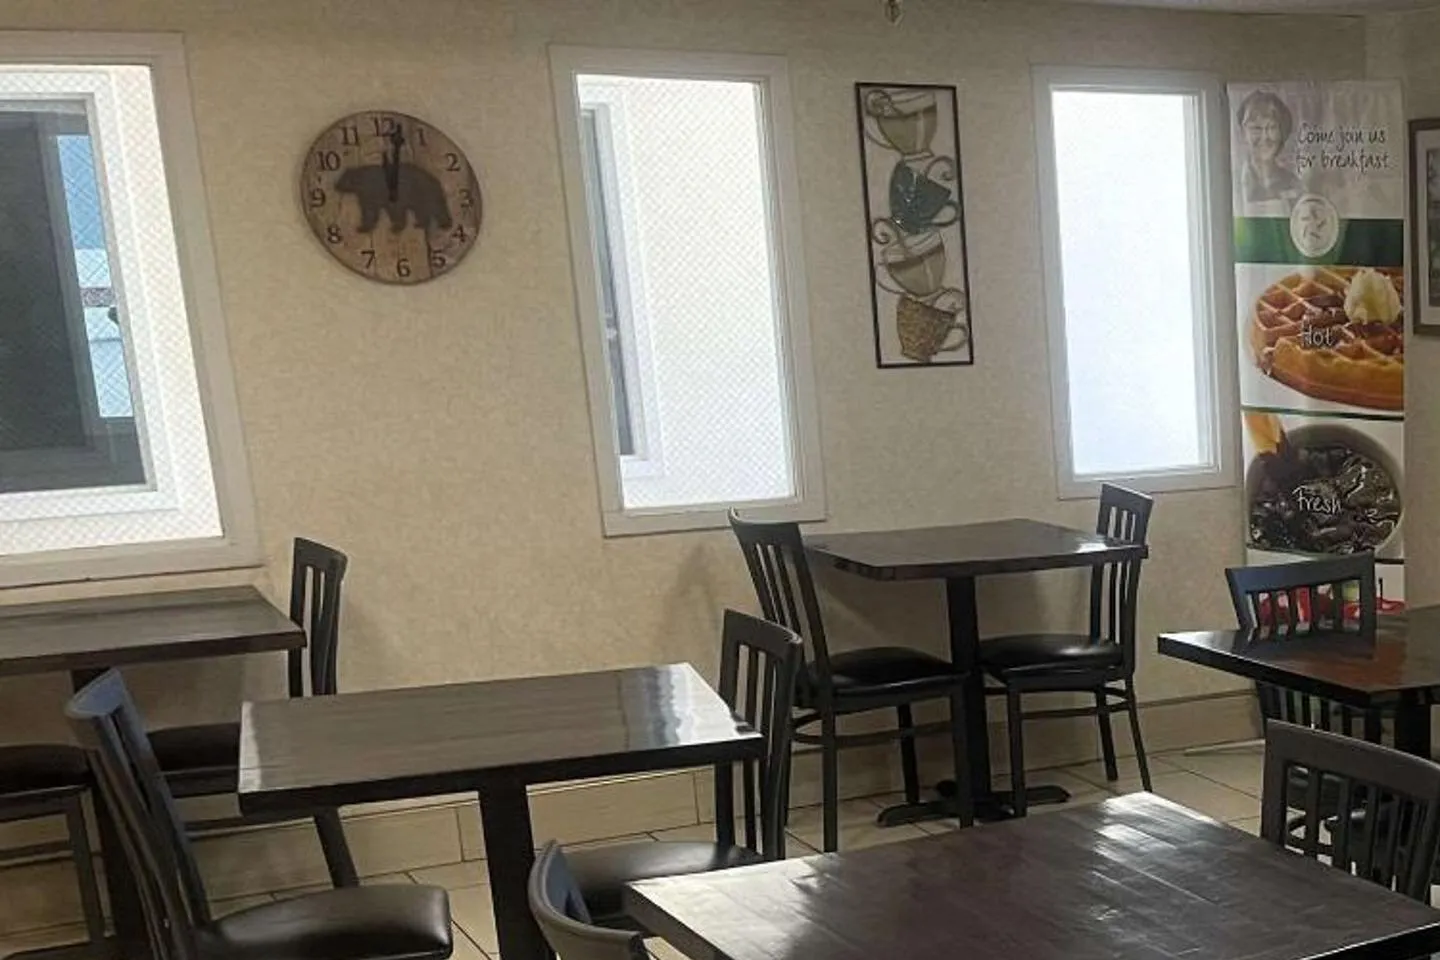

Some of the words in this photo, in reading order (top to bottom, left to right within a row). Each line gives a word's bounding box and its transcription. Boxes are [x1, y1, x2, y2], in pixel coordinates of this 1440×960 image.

[339, 126, 360, 147] 11
[373, 117, 397, 137] 12
[1299, 122, 1334, 143] Come
[1336, 126, 1363, 152] join
[1368, 129, 1385, 144] us
[416, 128, 428, 147] 1
[317, 151, 341, 171] 10
[445, 152, 461, 172] 2
[1296, 153, 1316, 173] for
[1321, 149, 1388, 174] breakfast
[309, 187, 327, 209] 9
[458, 188, 475, 209] 3
[326, 223, 344, 244] 8
[451, 224, 468, 243] 4
[360, 249, 376, 269] 7
[396, 258, 412, 278] 6
[431, 251, 447, 269] 5
[1301, 320, 1335, 346] Hot
